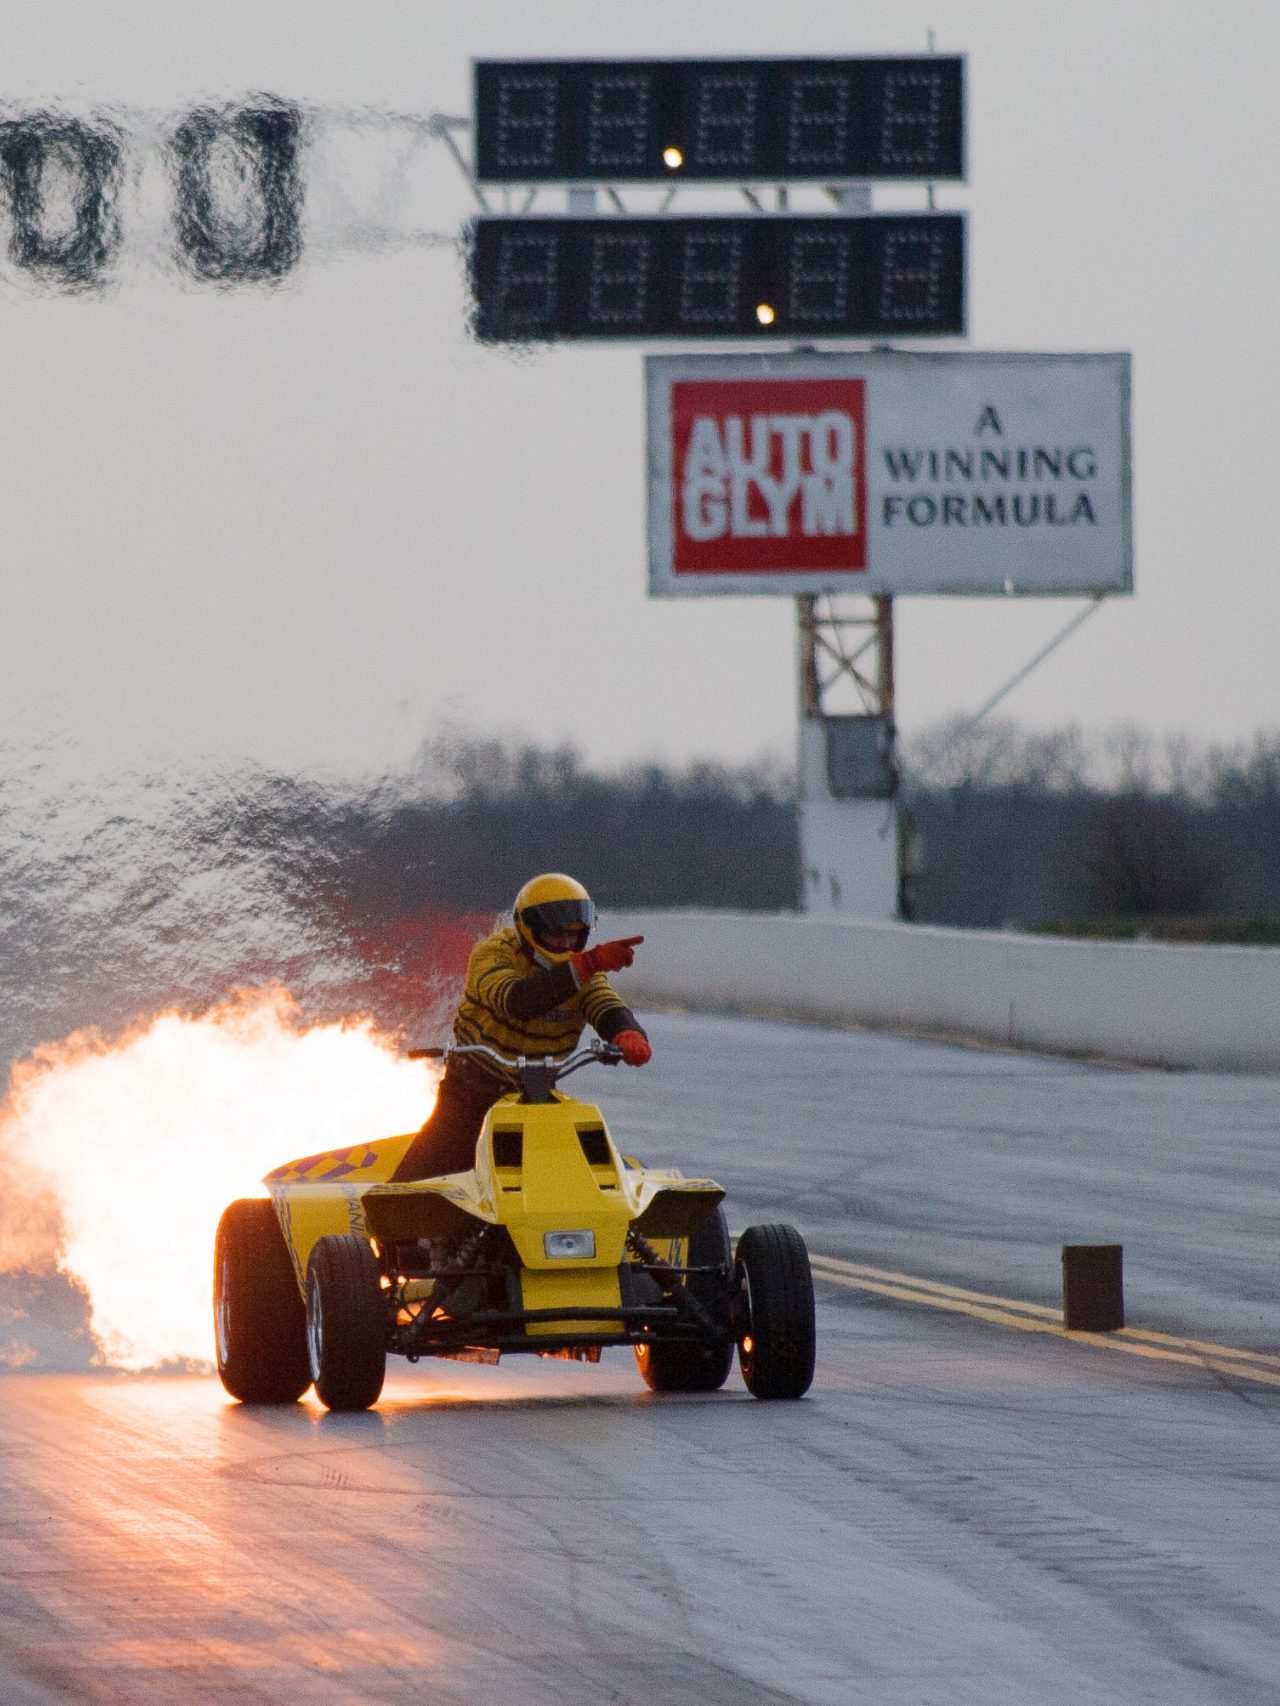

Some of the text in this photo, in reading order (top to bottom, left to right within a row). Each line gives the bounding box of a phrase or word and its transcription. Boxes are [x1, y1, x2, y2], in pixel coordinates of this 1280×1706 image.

[975, 404, 1003, 436] A
[686, 410, 856, 484] AUTO
[883, 447, 1097, 481] WINNING
[682, 472, 857, 542] GLYM
[882, 494, 1096, 527] FORMULA
